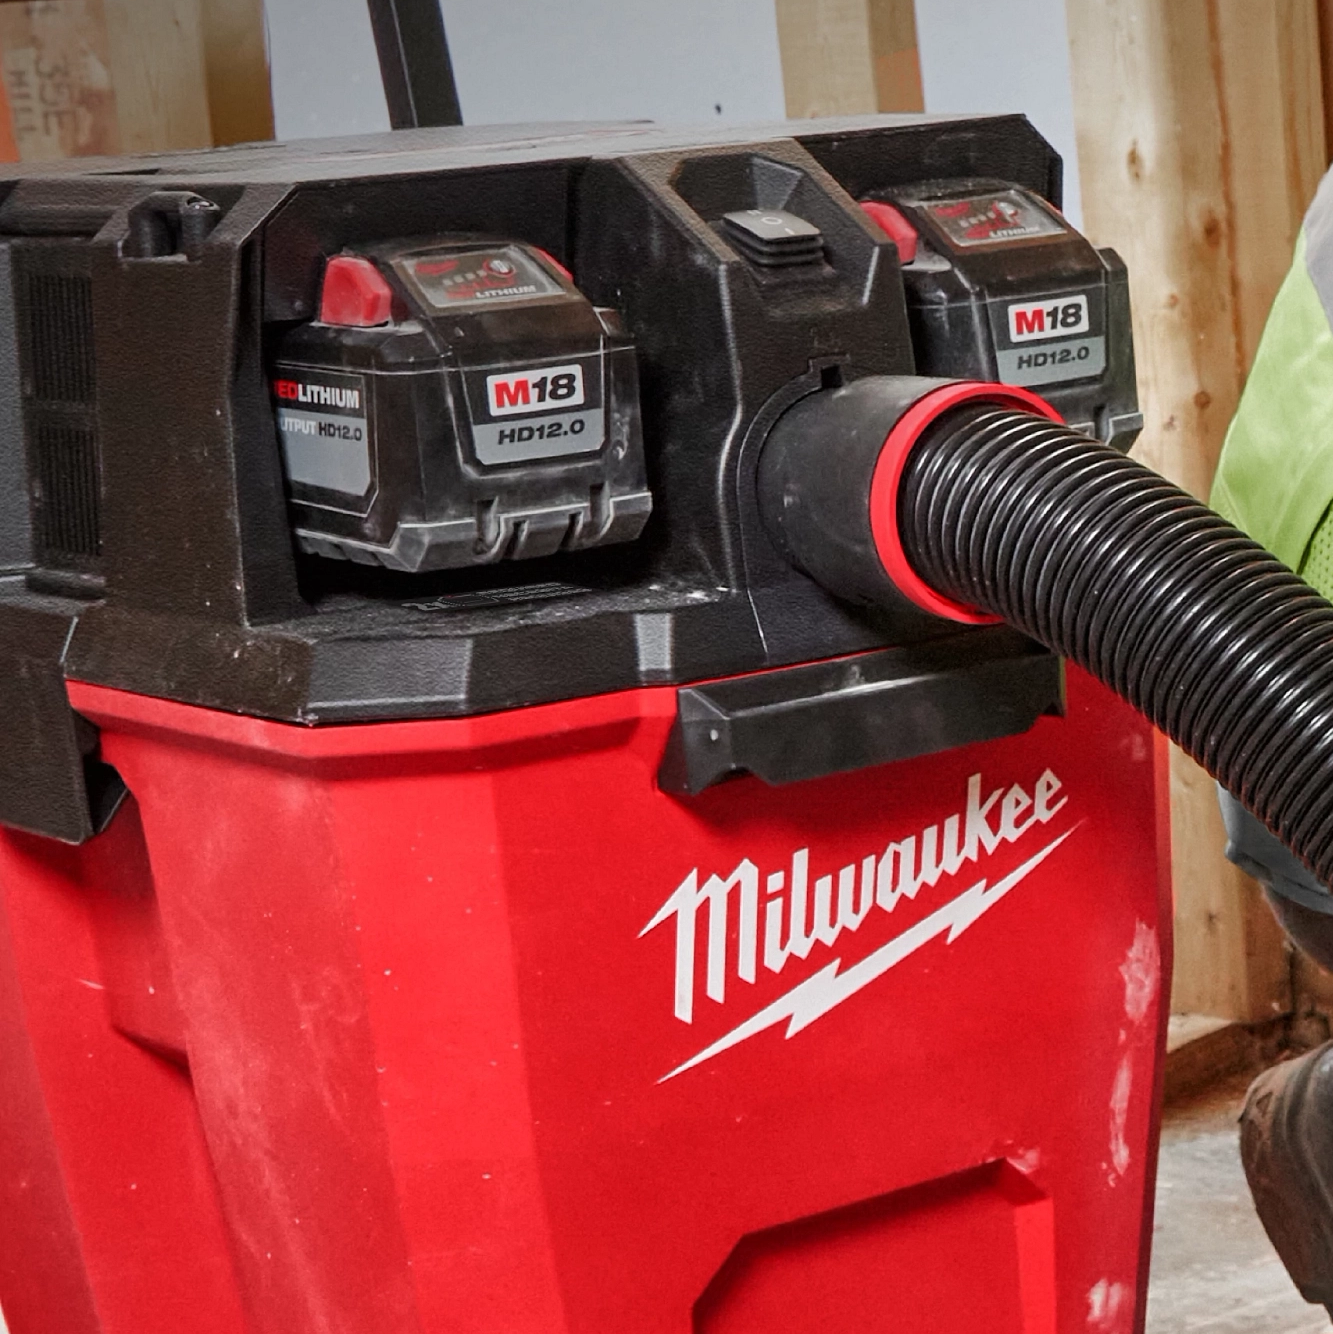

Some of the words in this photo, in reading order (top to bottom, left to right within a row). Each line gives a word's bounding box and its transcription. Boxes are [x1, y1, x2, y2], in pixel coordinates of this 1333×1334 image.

[445, 285, 537, 299] LITHIUM
[1015, 303, 1082, 335] M18
[1017, 346, 1090, 370] HD12.0
[274, 380, 360, 409] EDLITHIUM
[494, 373, 577, 408] M18
[281, 416, 317, 436] UTPUT
[318, 421, 363, 442] HD12.0
[497, 419, 586, 445] HD12.0
[637, 768, 1068, 1025] Milwaukee
